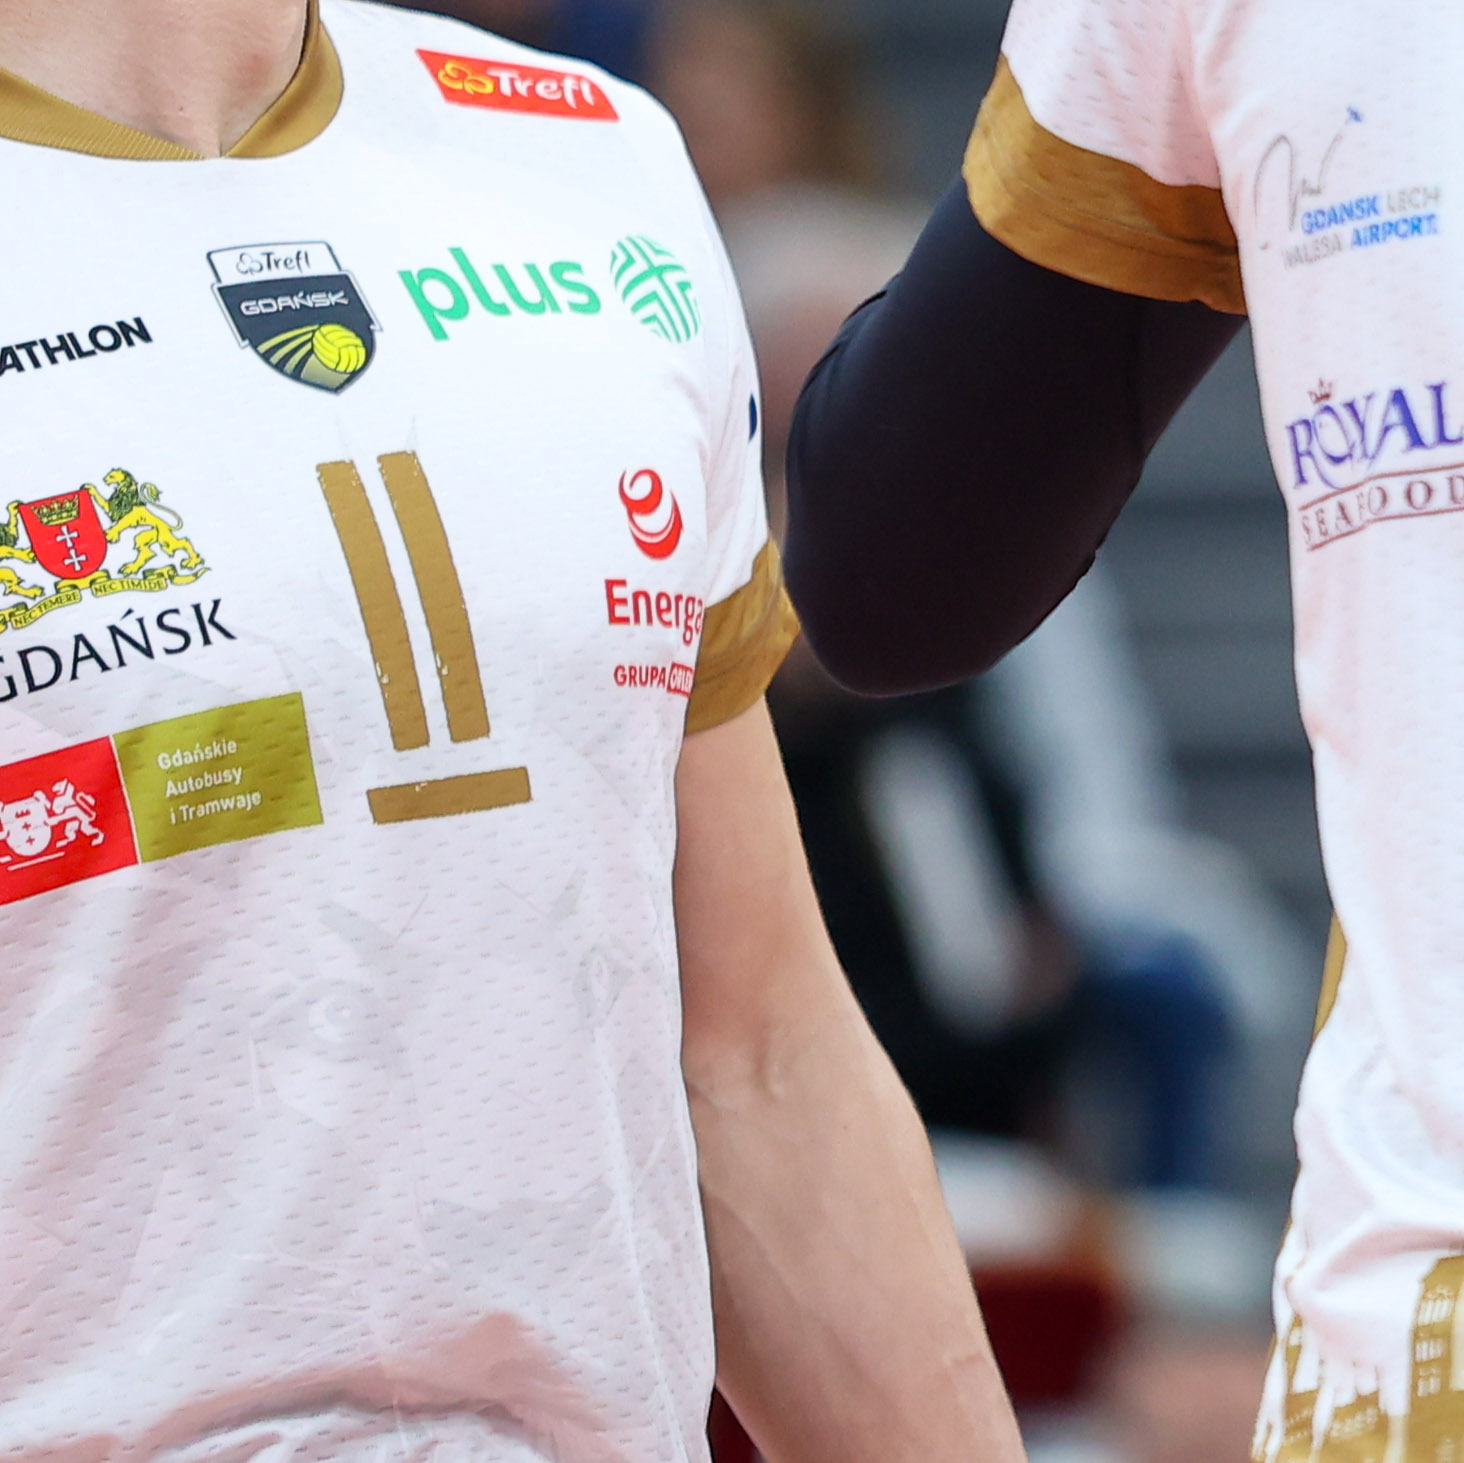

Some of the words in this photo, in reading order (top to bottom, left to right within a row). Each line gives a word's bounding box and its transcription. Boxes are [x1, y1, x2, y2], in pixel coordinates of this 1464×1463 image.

[486, 67, 596, 110] Trefl
[262, 249, 311, 274] Trefl
[240, 290, 349, 316] GDAŃSK
[397, 246, 602, 342] plus
[316, 448, 491, 752] 11
[604, 578, 703, 647] Energa
[614, 663, 666, 688] GRUPA
[157, 737, 237, 770] Gdańskie
[166, 766, 243, 799] Autobusy
[170, 807, 177, 825] i
[179, 791, 262, 822] Tramwaje
